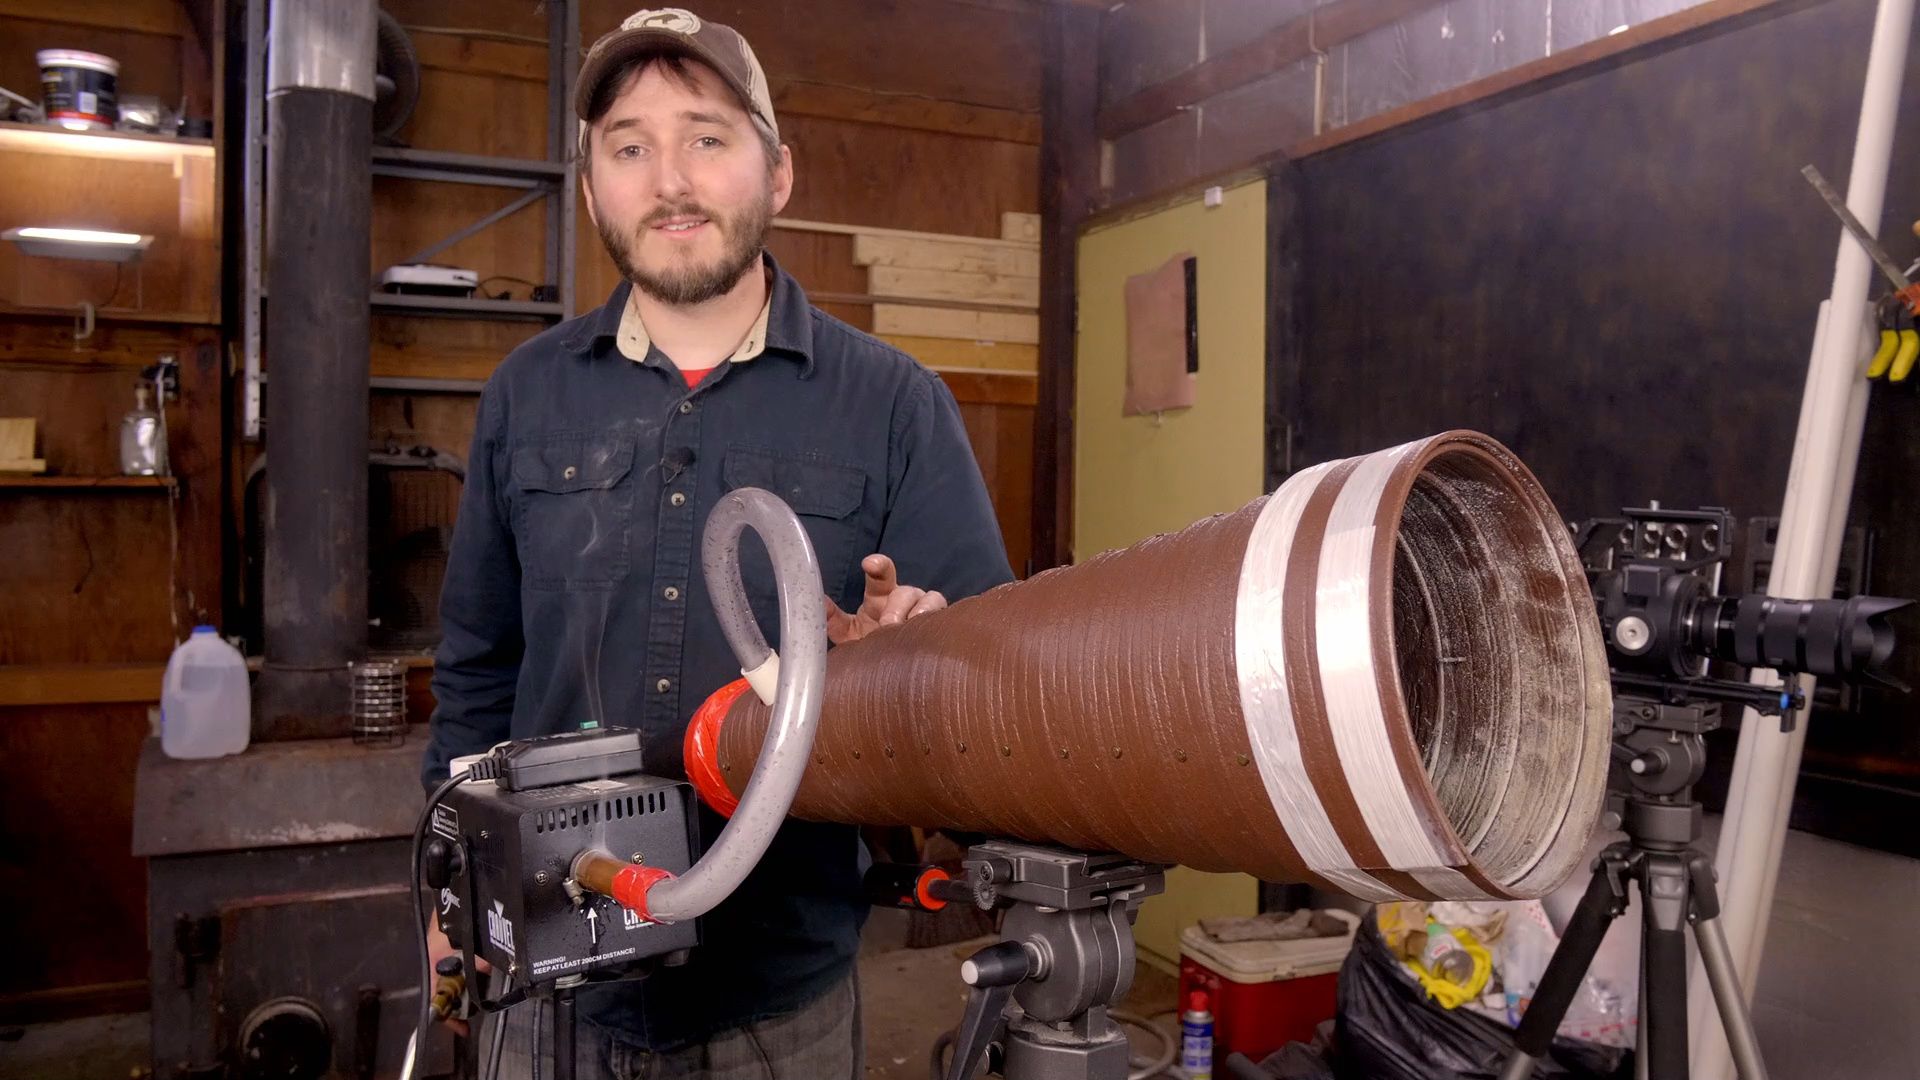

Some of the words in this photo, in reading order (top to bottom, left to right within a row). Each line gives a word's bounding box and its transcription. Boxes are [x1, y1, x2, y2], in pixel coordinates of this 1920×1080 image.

[533, 965, 551, 975] KEEP
[551, 964, 559, 972] AT
[560, 959, 581, 969] LEAST
[581, 955, 602, 964] 200CM
[603, 947, 636, 959] DISTANCE!
[533, 956, 566, 968] WARNING!
